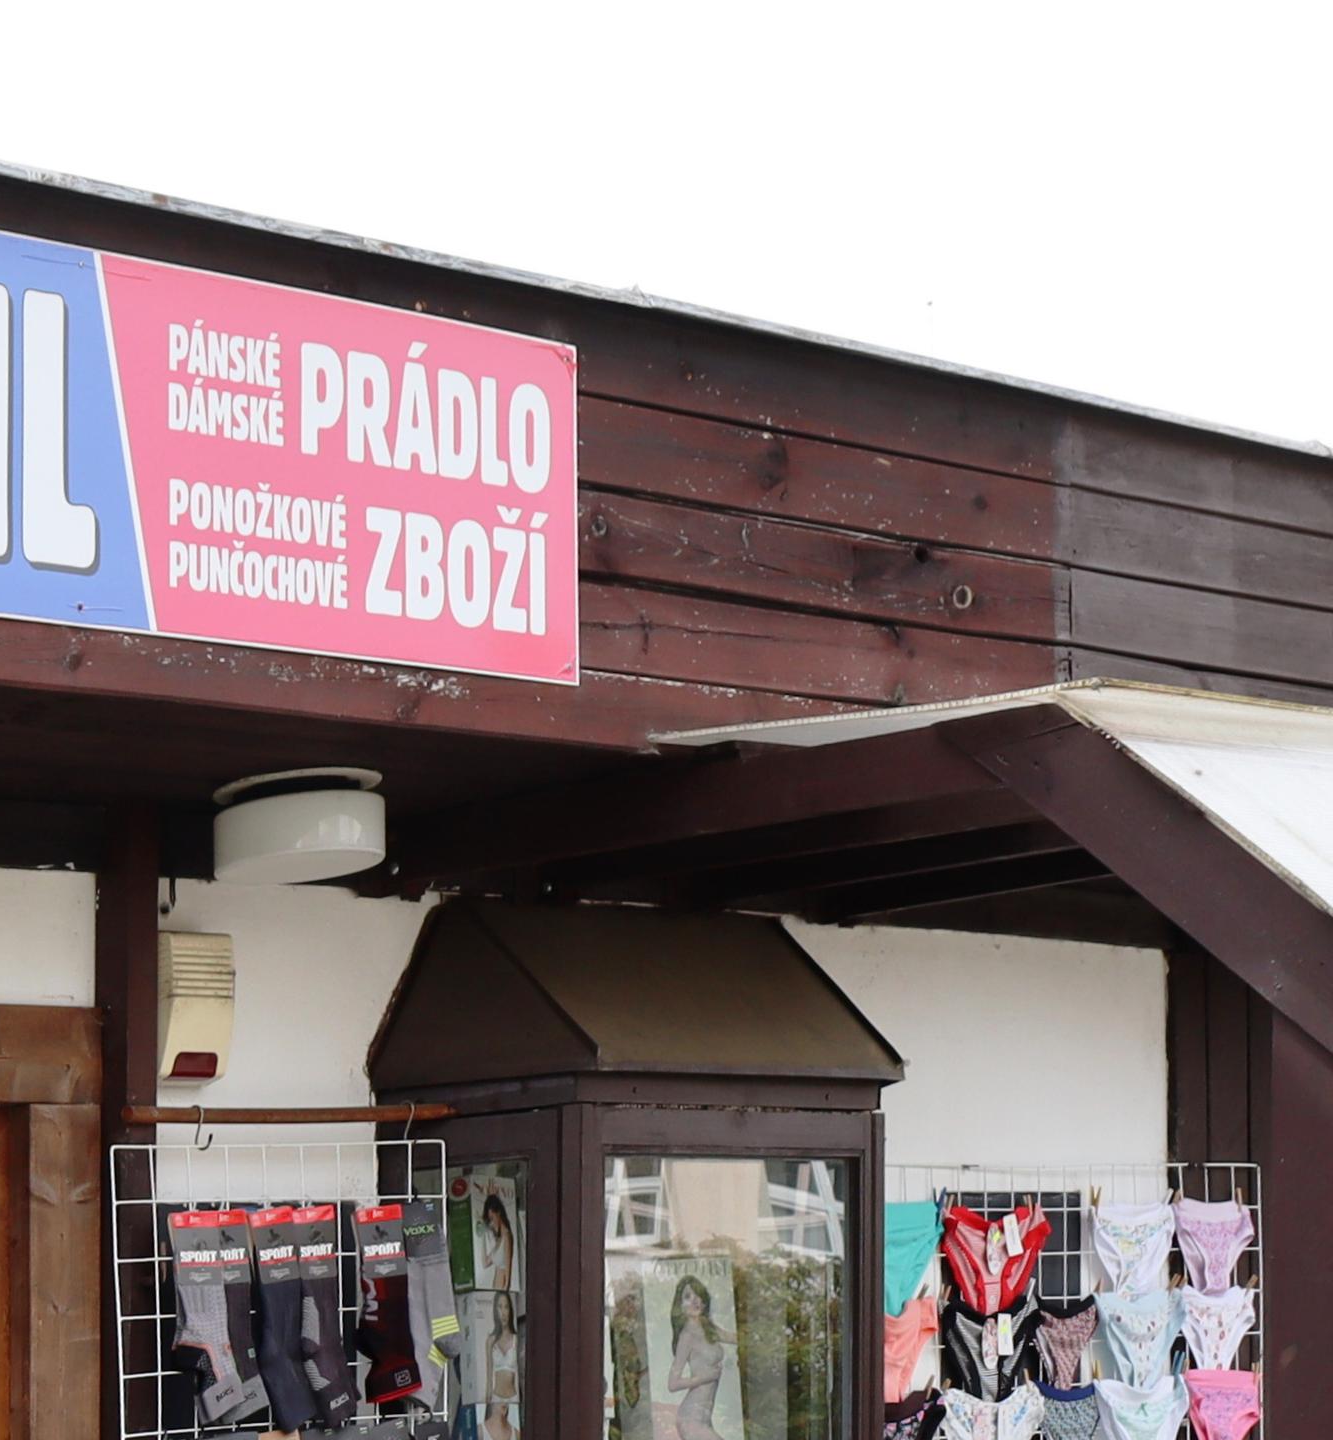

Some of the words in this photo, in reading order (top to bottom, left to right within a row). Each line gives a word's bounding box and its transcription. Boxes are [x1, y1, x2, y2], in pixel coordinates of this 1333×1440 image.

[167, 318, 281, 388] PÁNSKÉ
[167, 381, 284, 447] DÁMSKÉ
[298, 341, 552, 494] PRÁDLO
[167, 477, 347, 550] PONOŽKOVÉ
[167, 540, 348, 610] PUNČOCHOVÉ
[364, 505, 547, 636] ZBOŽÍ
[180, 1250, 217, 1263] SPORT
[259, 1245, 294, 1261] SPORT
[300, 1243, 333, 1258] SPORT
[363, 1242, 402, 1257] SPORT
